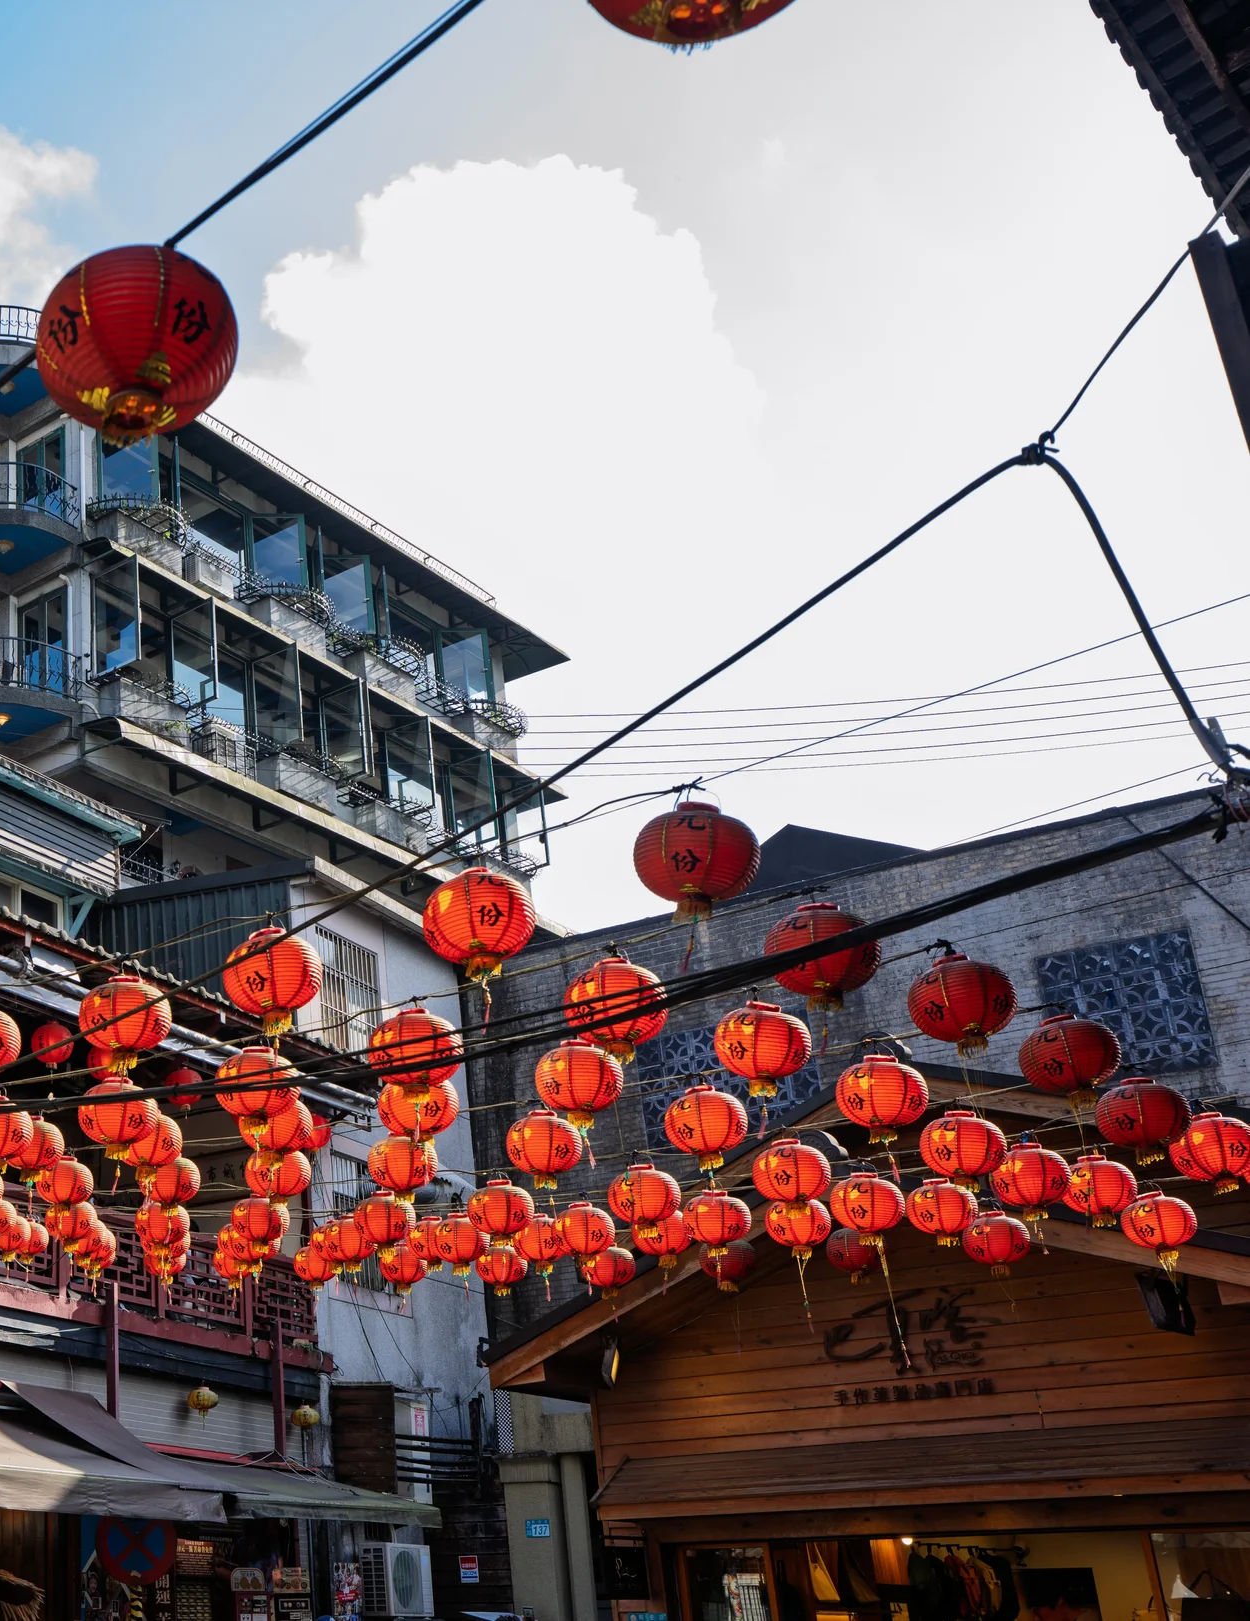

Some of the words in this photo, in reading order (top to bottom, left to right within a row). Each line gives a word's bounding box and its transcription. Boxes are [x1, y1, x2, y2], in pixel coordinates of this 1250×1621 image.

[670, 814, 707, 874] 九份
[476, 873, 506, 928] 九份
[916, 971, 946, 1022] 九份
[727, 1012, 754, 1062] 九份
[1034, 1028, 1065, 1078] 九份
[543, 1050, 563, 1096] 九份
[847, 1065, 868, 1111] 九份
[128, 1113, 145, 1129] 份
[424, 1100, 442, 1117] 份
[675, 1098, 695, 1141] 九份
[1113, 1086, 1138, 1132] 九份
[935, 1120, 956, 1162] 九份
[773, 1147, 793, 1187] 九份
[1071, 1167, 1090, 1203] 九份
[850, 1181, 869, 1220] 九份
[919, 1188, 935, 1223] 九份
[1137, 1203, 1157, 1238] 九份
[533, 1525, 548, 1535] 137
